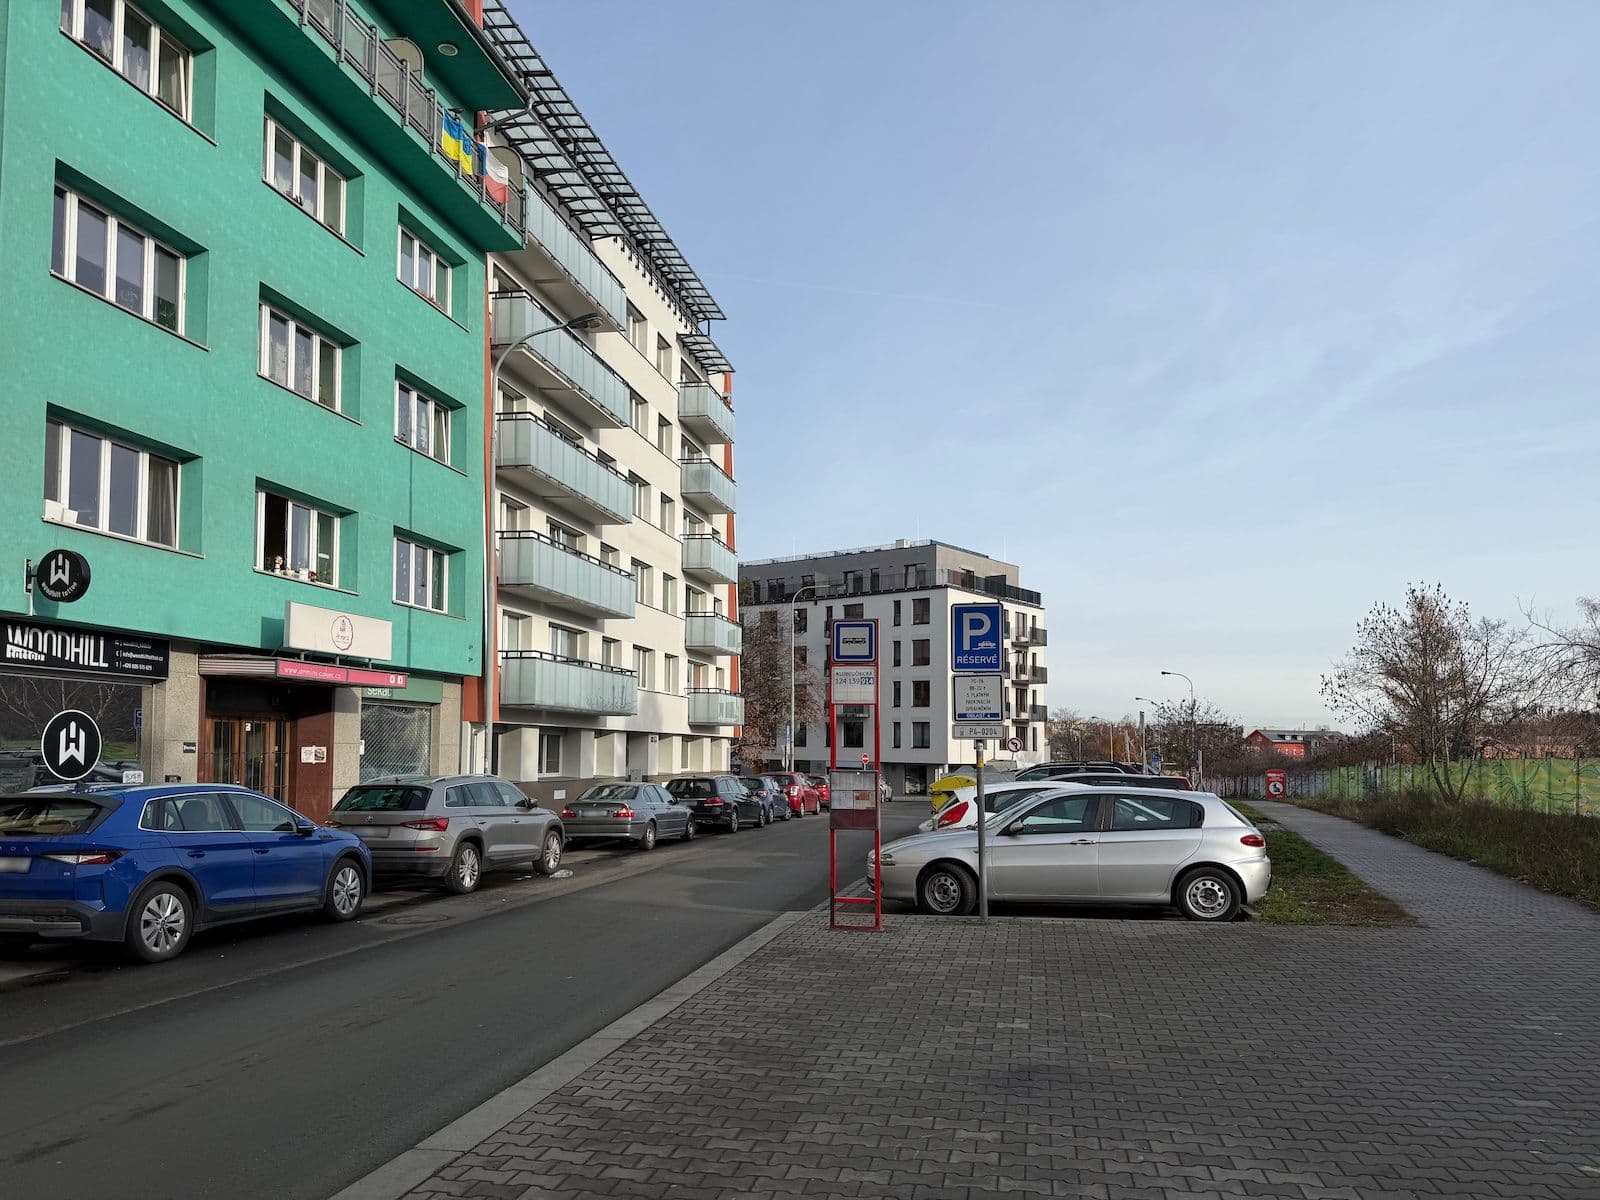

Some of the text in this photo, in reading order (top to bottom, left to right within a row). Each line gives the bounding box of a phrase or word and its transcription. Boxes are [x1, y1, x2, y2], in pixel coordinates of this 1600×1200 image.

[962, 612, 991, 650] P
[7, 624, 109, 668] WOODHILL
[956, 654, 998, 664] RÉSERVÉ
[969, 727, 998, 736] P4-0204
